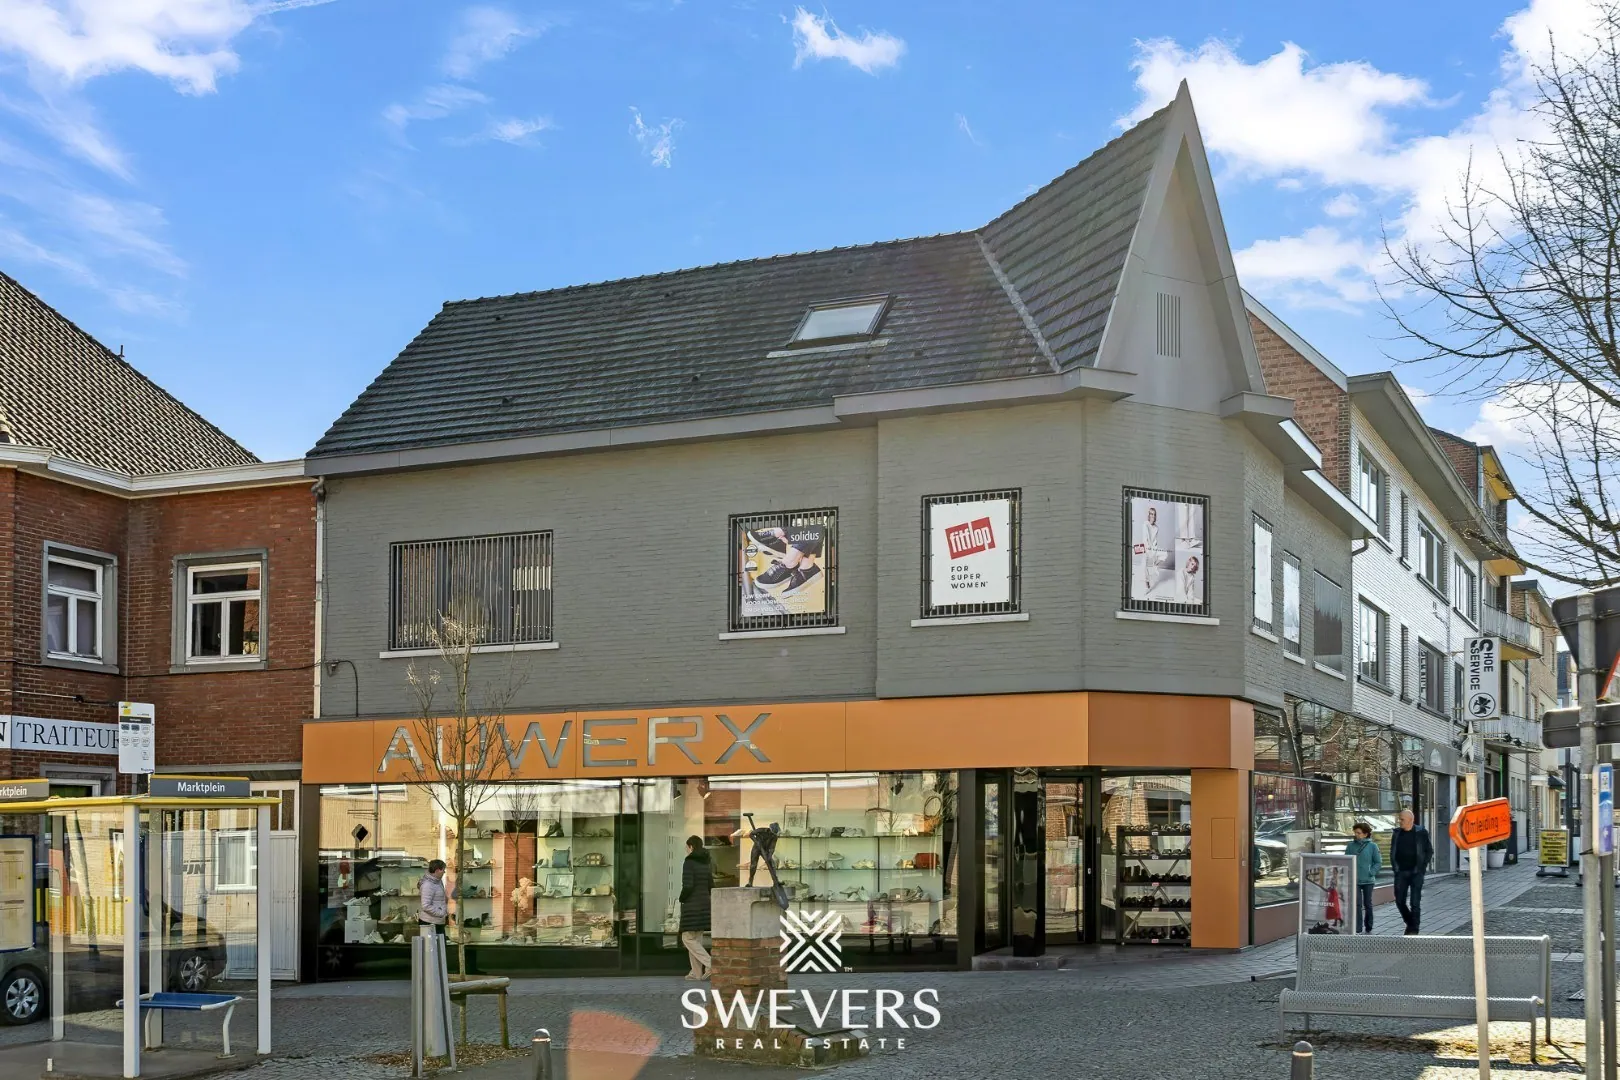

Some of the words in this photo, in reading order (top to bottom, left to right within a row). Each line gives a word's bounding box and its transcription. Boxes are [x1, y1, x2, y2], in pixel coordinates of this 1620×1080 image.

[790, 530, 820, 542] solidus
[949, 523, 992, 553] fitflop
[951, 573, 981, 581] SUPER
[1477, 638, 1494, 672] SHOE
[1470, 647, 1480, 690] SERVICE
[377, 713, 772, 773] AUWERX
[177, 781, 225, 794] Marktplein
[1464, 816, 1499, 836] Omleiding
